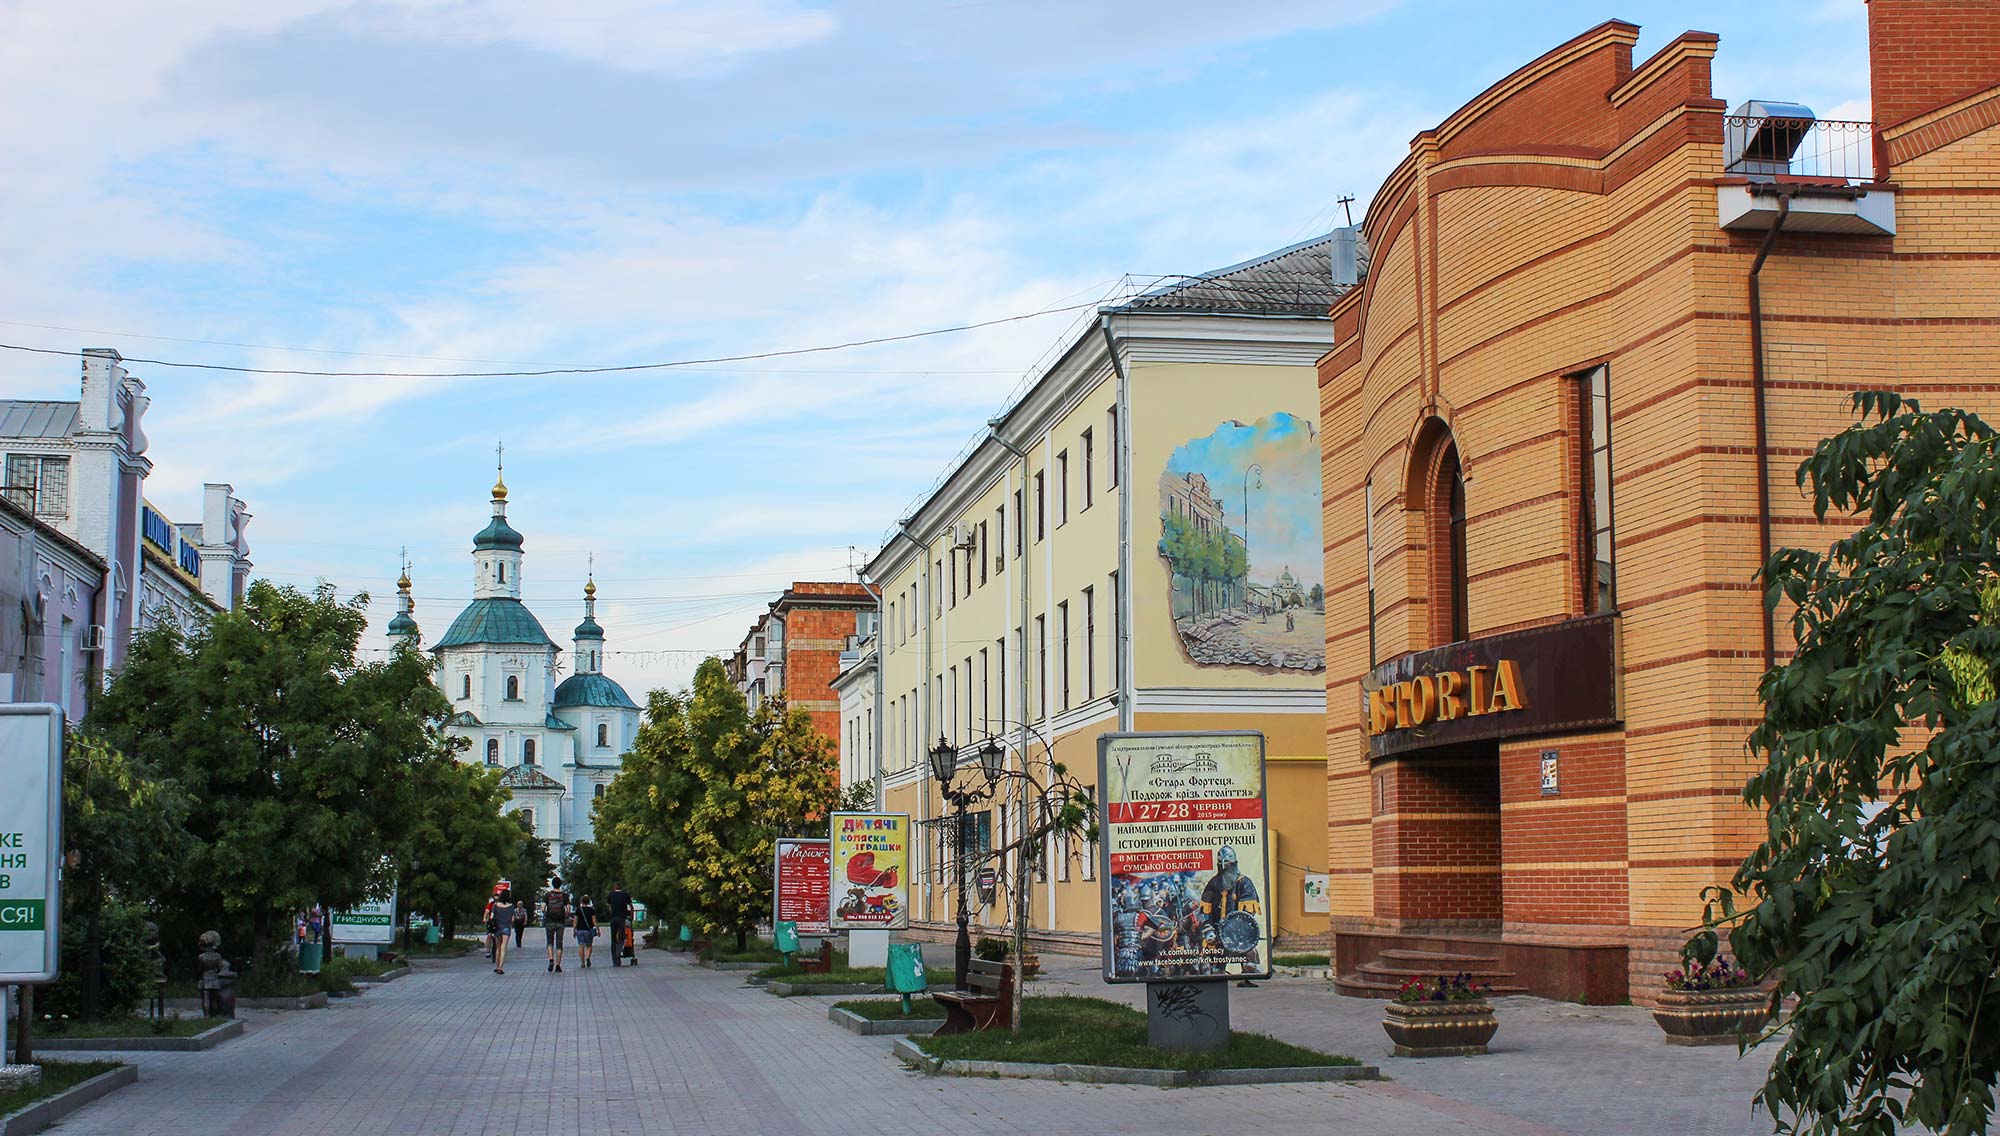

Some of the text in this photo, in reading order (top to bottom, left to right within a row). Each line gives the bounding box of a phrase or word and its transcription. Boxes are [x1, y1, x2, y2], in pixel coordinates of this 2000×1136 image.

[1367, 659, 1523, 737] ASTORIA
[1149, 777, 1185, 789] «Стара
[1131, 788, 1253, 801] Подорож крізь століття»
[1140, 803, 1232, 819] 27-28 ЧЕРВНЯ
[842, 819, 897, 832] ДИТЯЧІ
[1117, 822, 1256, 835] НАЙМАСШТАБНІШИЙ ФЕСТИВАЛЬ
[841, 834, 886, 842] КОЛЯСКИ
[1118, 834, 1256, 849] ІСТОРИЧНОЇ РЕКОНСТРУКЦІЇ
[786, 844, 824, 863] Париж
[1126, 854, 1149, 862] МІСТІ
[1150, 851, 1204, 861] ТРОСТЯНЕЦЬ
[1, 853, 27, 868] НЯ
[1123, 862, 1164, 871] СУМСЬКОЇ
[1, 907, 34, 923] СЯ!
[1159, 948, 1224, 956] vk.com/stara_fortecy
